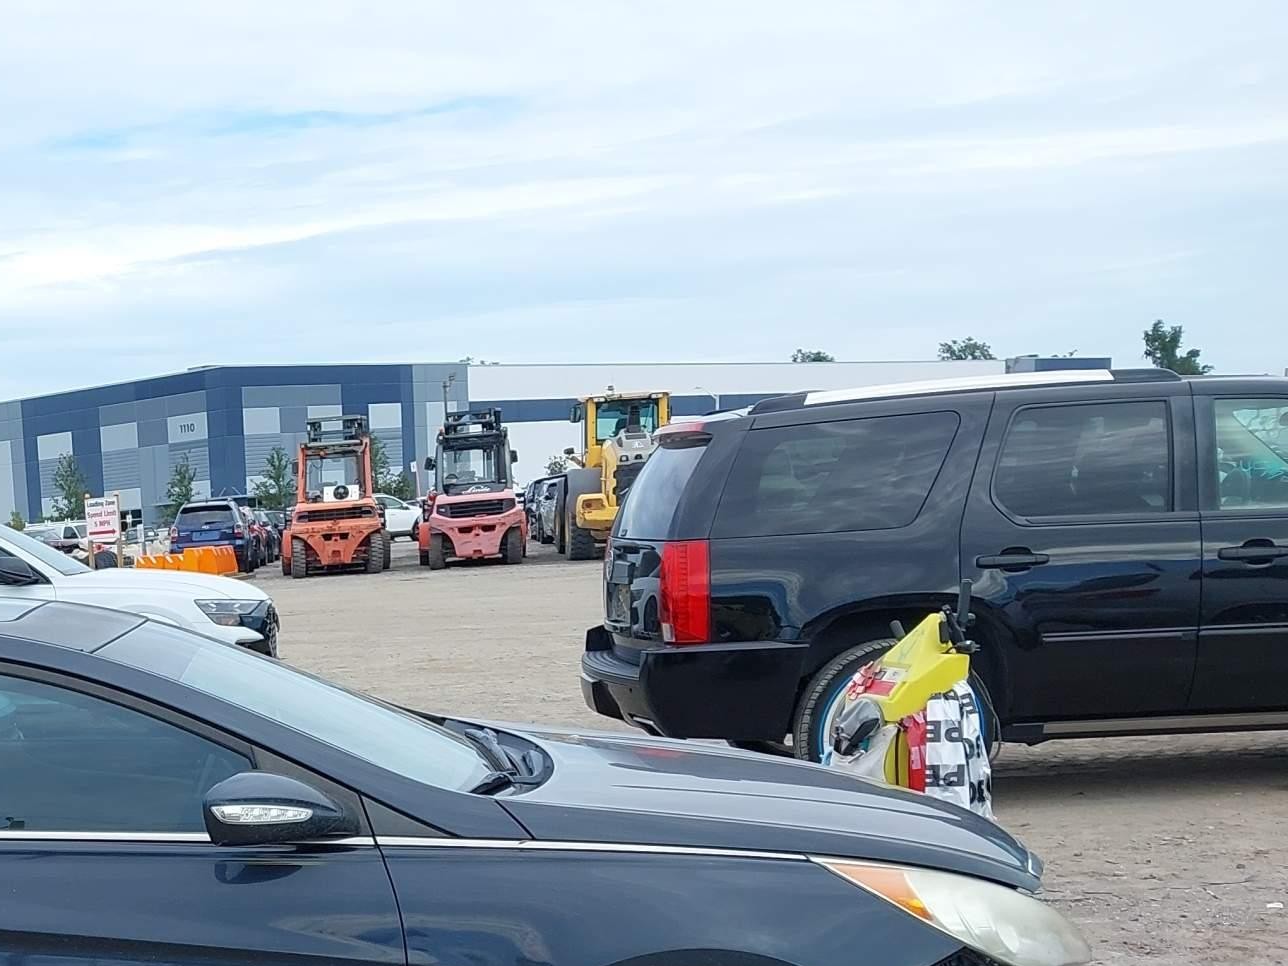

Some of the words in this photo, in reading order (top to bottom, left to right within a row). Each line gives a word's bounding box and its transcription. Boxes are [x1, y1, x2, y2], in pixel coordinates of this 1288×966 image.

[179, 423, 195, 433] 1110
[87, 511, 103, 519] Speed
[104, 509, 117, 517] Limit
